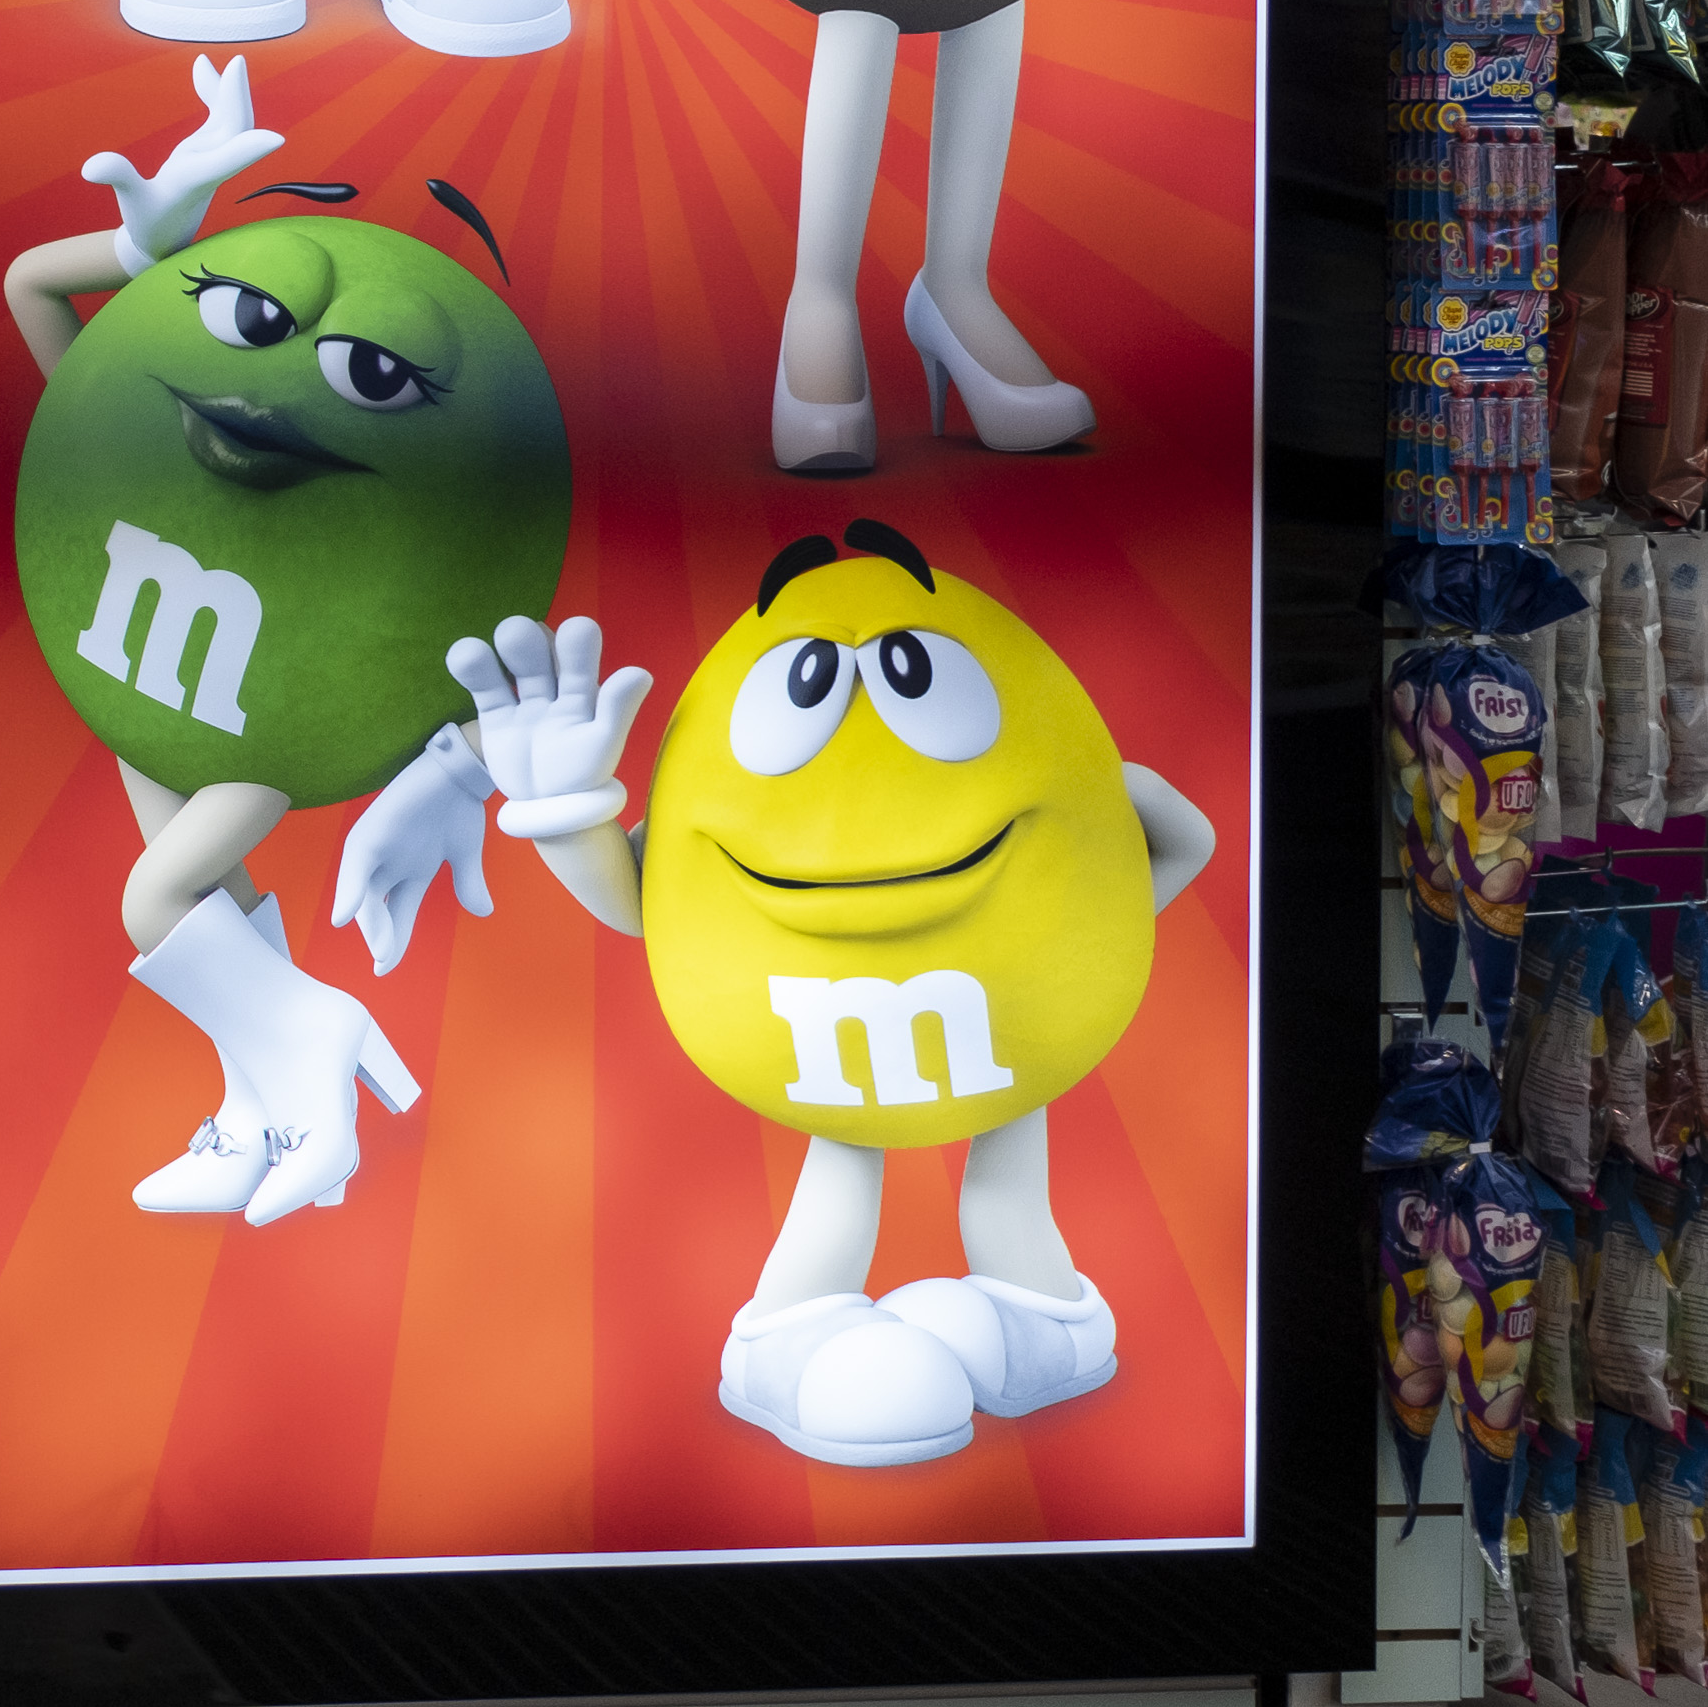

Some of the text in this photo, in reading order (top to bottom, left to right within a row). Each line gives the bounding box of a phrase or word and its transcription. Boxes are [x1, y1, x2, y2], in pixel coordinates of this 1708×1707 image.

[1448, 55, 1527, 100] MELODY
[1490, 83, 1531, 96] POPS
[1440, 307, 1519, 356] MELODY
[1483, 335, 1524, 350] POPS
[75, 518, 263, 736] m
[1504, 779, 1534, 807] UFO
[768, 967, 1013, 1108] m
